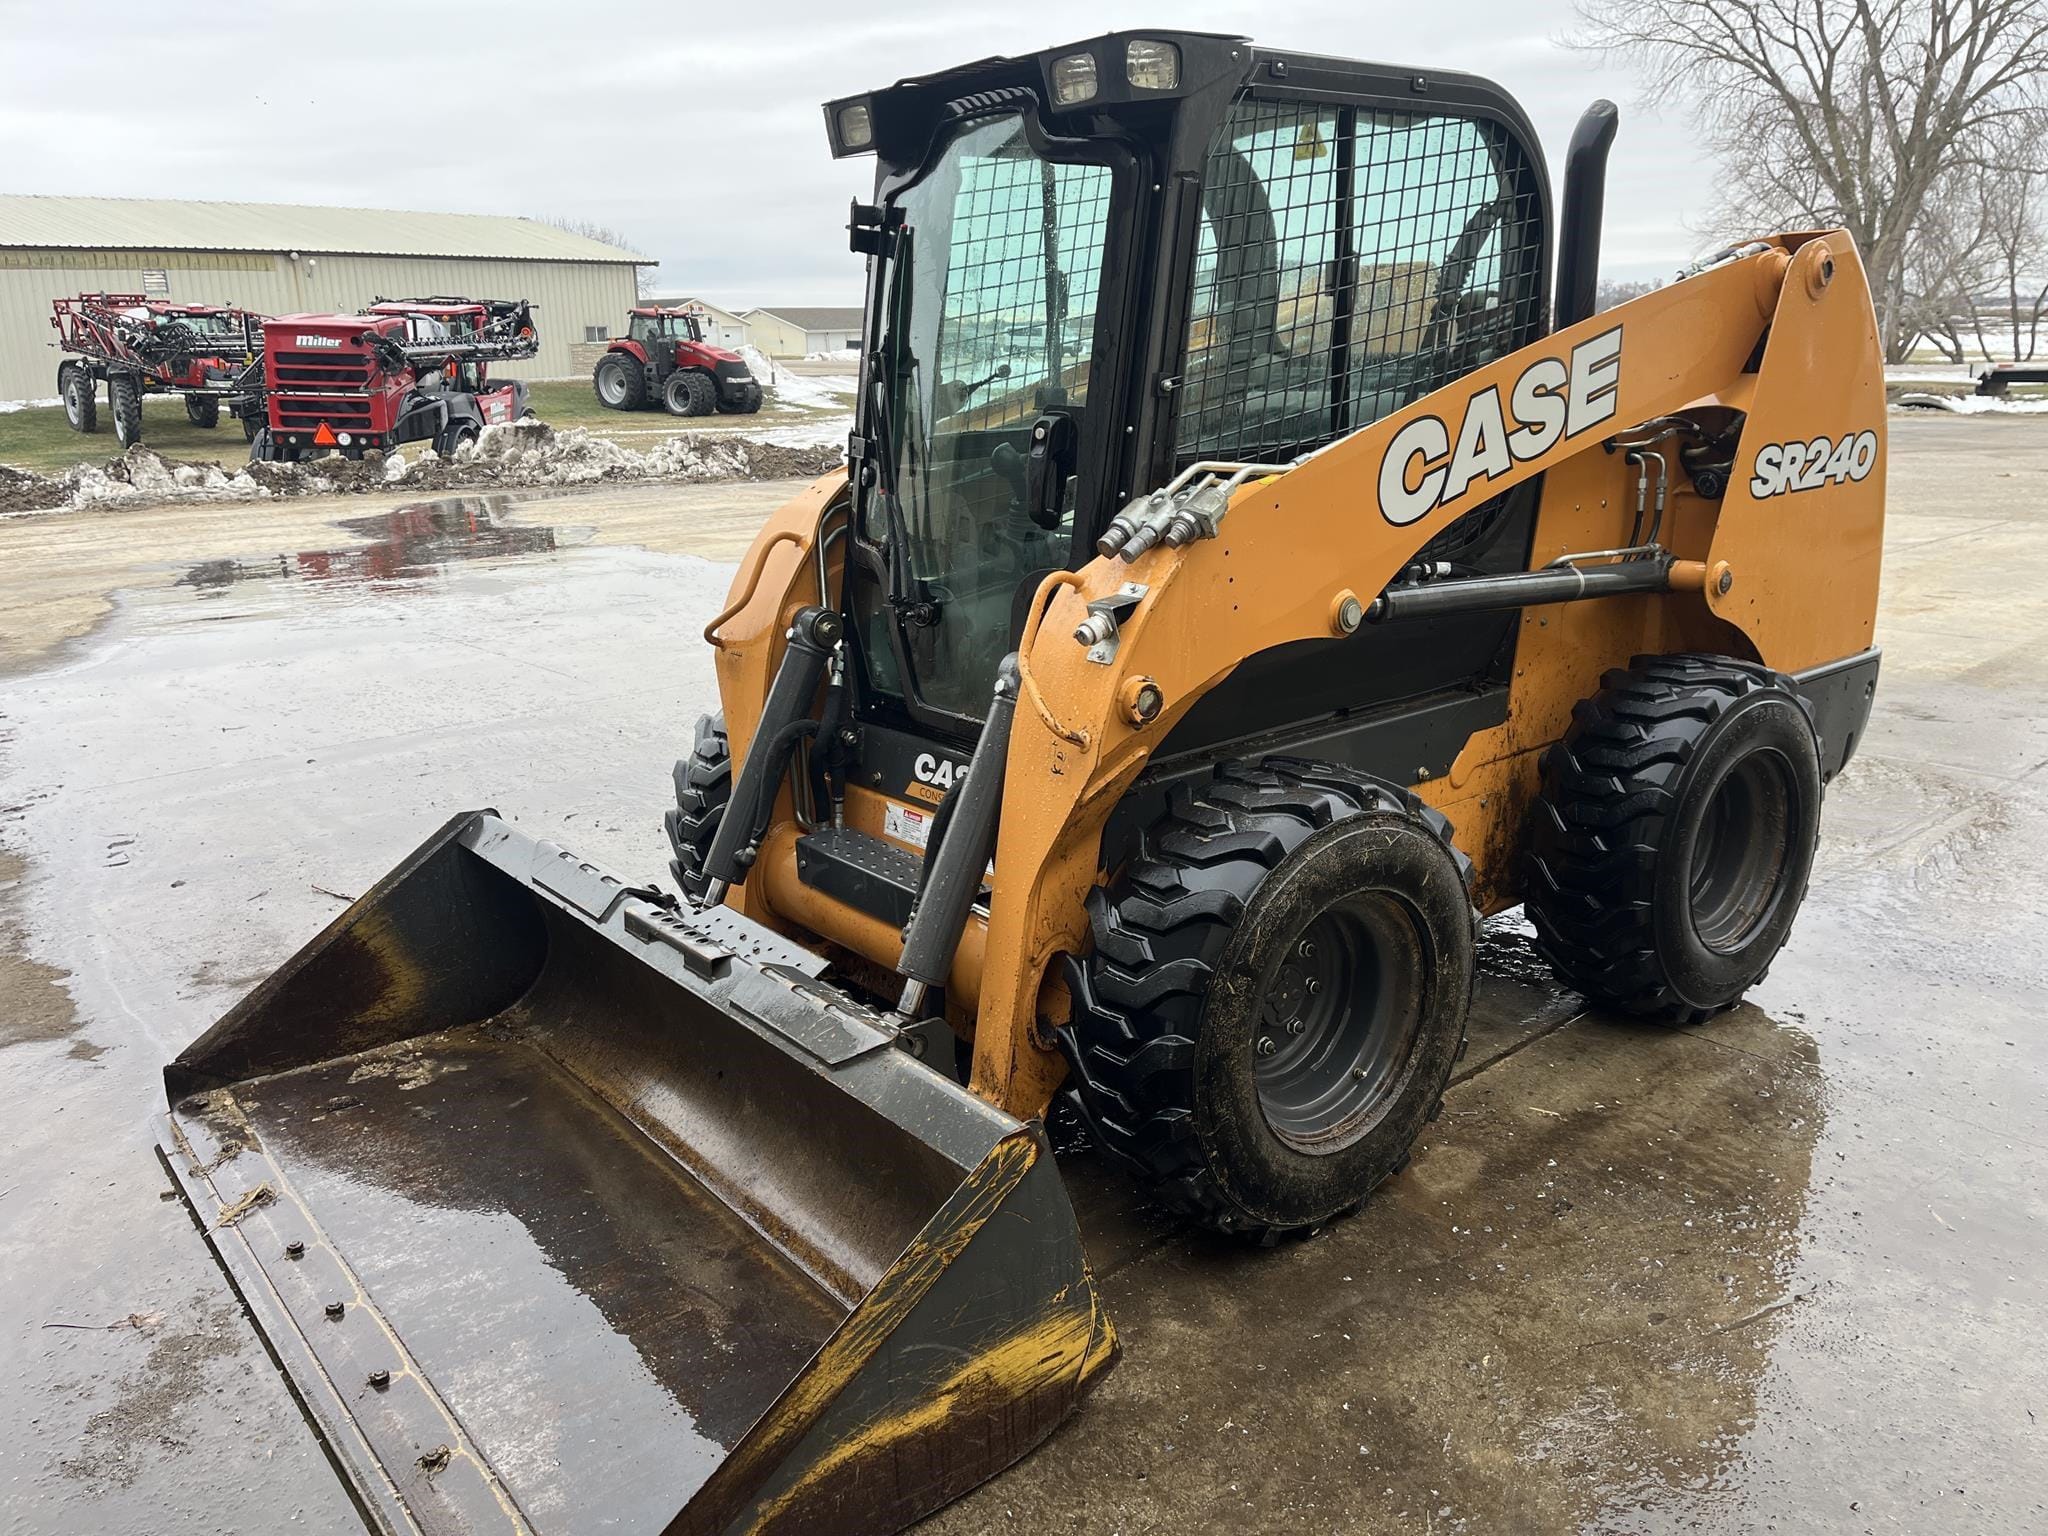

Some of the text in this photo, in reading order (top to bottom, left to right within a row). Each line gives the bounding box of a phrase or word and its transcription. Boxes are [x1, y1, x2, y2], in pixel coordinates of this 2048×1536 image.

[295, 335, 342, 348] Miller
[1377, 323, 1624, 527] CASE
[1750, 429, 1878, 500] SR240
